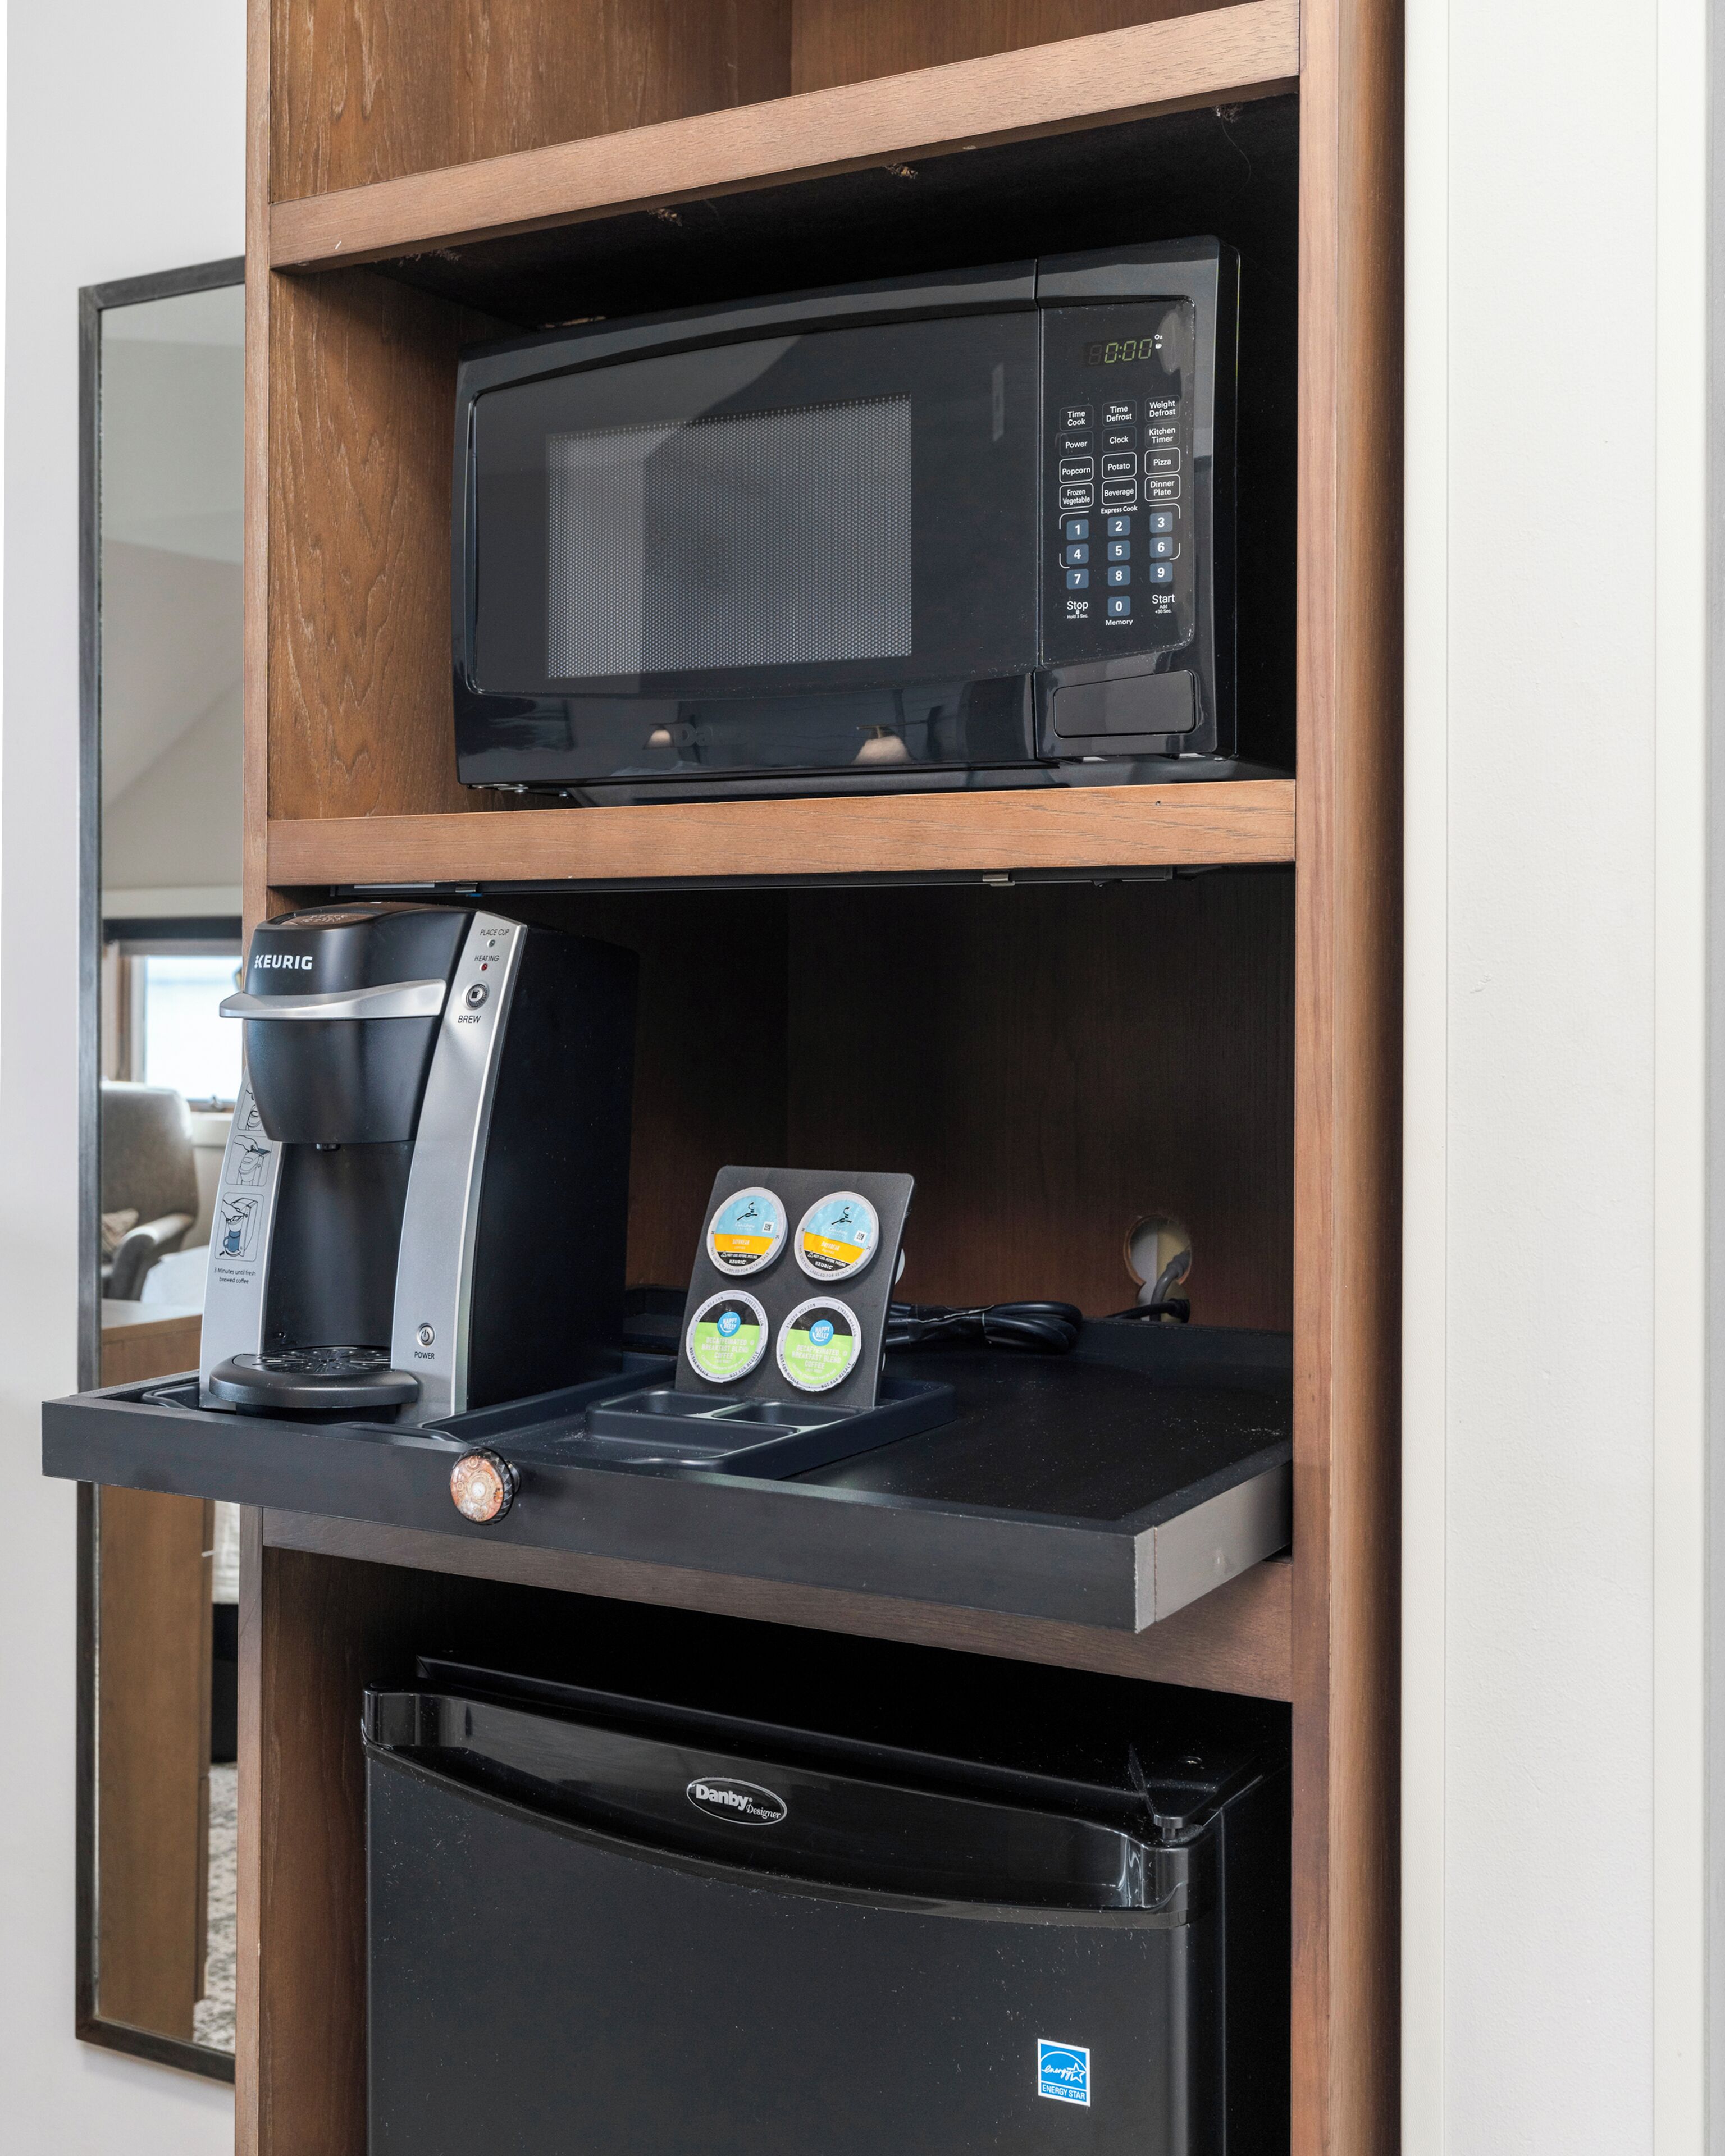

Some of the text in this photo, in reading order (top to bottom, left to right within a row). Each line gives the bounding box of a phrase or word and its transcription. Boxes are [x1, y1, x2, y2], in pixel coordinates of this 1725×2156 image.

[1105, 339, 1153, 363] 0:00
[1149, 400, 1175, 409] Weight
[1106, 413, 1132, 422] Defrost
[1149, 408, 1176, 418] Defrost
[1149, 427, 1176, 436] Kitchen
[1104, 488, 1134, 497] Beverage
[1063, 496, 1090, 505] Vegetable
[1101, 506, 1122, 515] Express
[1115, 521, 1122, 531] 2
[1157, 517, 1165, 528] 3
[1075, 524, 1080, 535] 1
[1115, 545, 1122, 556] 5
[1157, 542, 1165, 552] 6
[1074, 549, 1081, 559] 4
[1115, 570, 1122, 581] 8
[1157, 567, 1165, 578] 9
[1074, 574, 1081, 584] 7
[1152, 594, 1175, 604] Start
[1067, 600, 1088, 611] Stop
[1115, 601, 1122, 611] 0
[254, 954, 312, 970] KEURIG
[458, 1015, 481, 1024] BREW
[815, 1261, 833, 1269] KEURIG
[706, 1337, 747, 1345] DECAFFEINATED
[792, 1351, 822, 1360] BREAKFAST
[796, 1345, 839, 1356] DECAFFEINATED
[805, 1360, 825, 1369] COFFEE
[696, 1784, 781, 1819] Danby Designer
[1042, 2065, 1070, 2081] energy
[1042, 2084, 1085, 2100] ENERGY STAR
